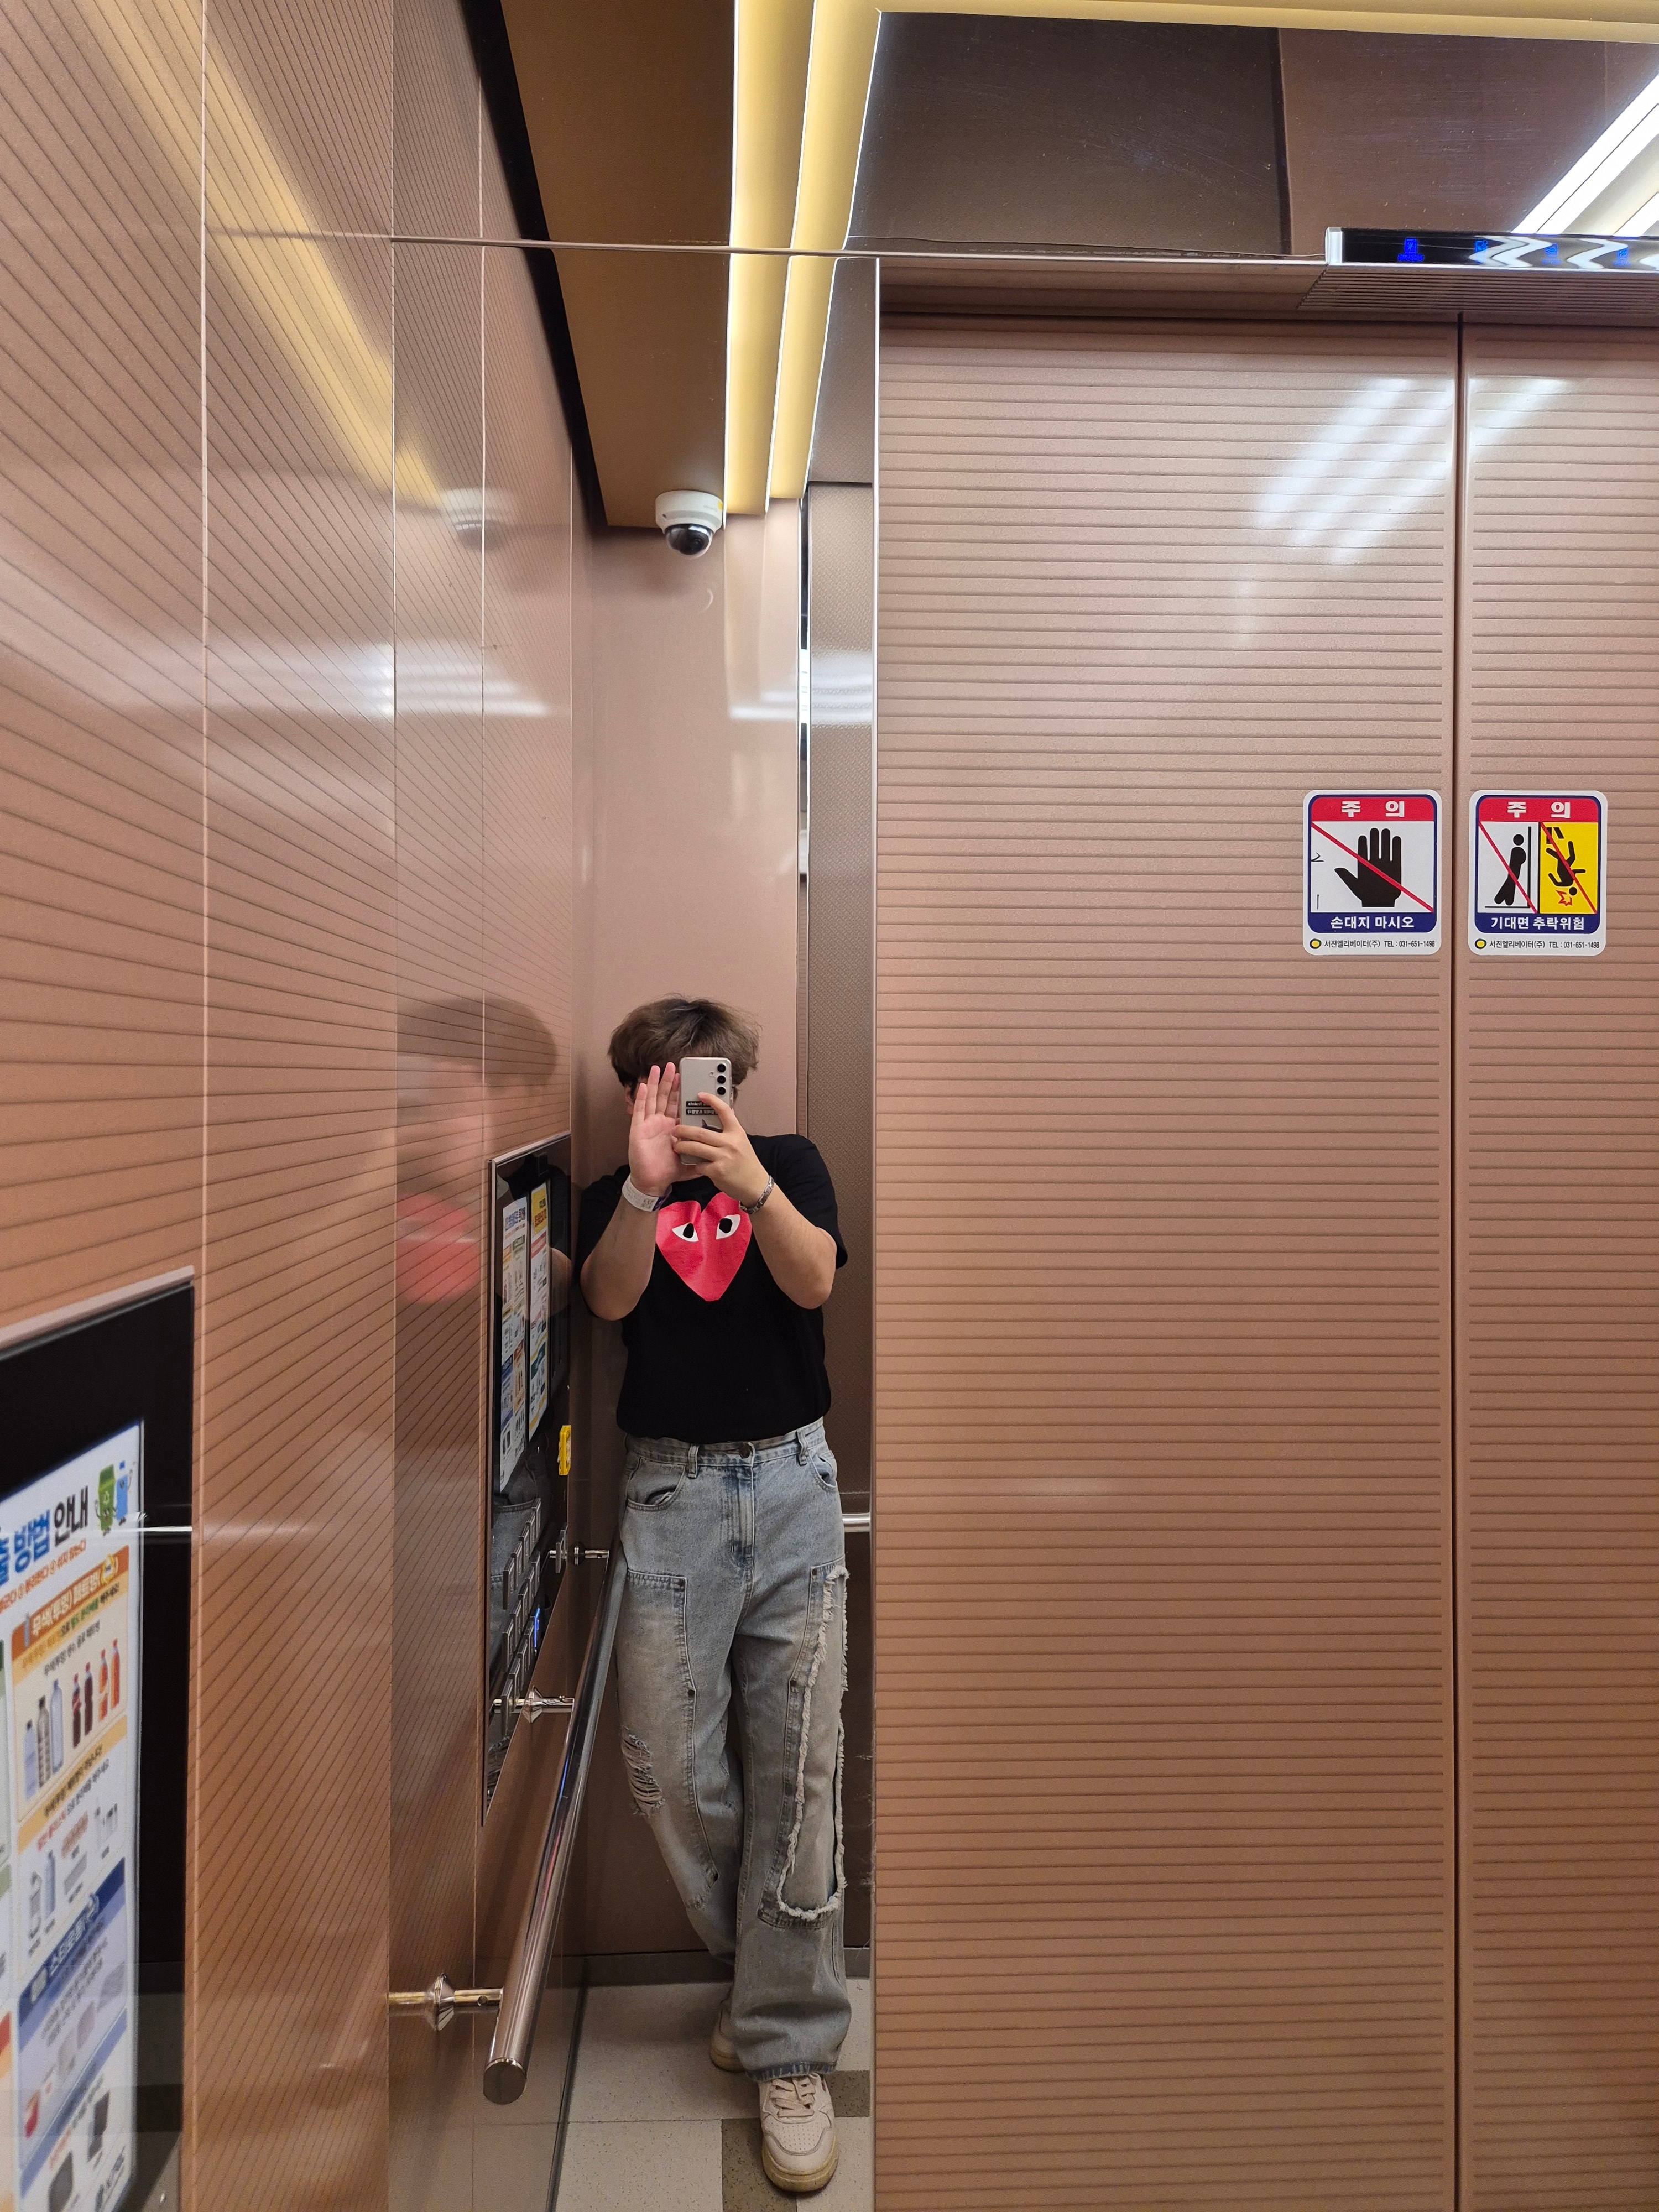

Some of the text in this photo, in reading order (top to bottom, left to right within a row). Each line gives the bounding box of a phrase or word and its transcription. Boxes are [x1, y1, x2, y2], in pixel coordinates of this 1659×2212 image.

[1330, 916, 1415, 929] 손대지 마시오
[1491, 916, 1585, 930] 기대면 추락위험
[1324, 940, 1380, 948] 서진엘리베이터(주)
[54, 1485, 88, 1547] 안내
